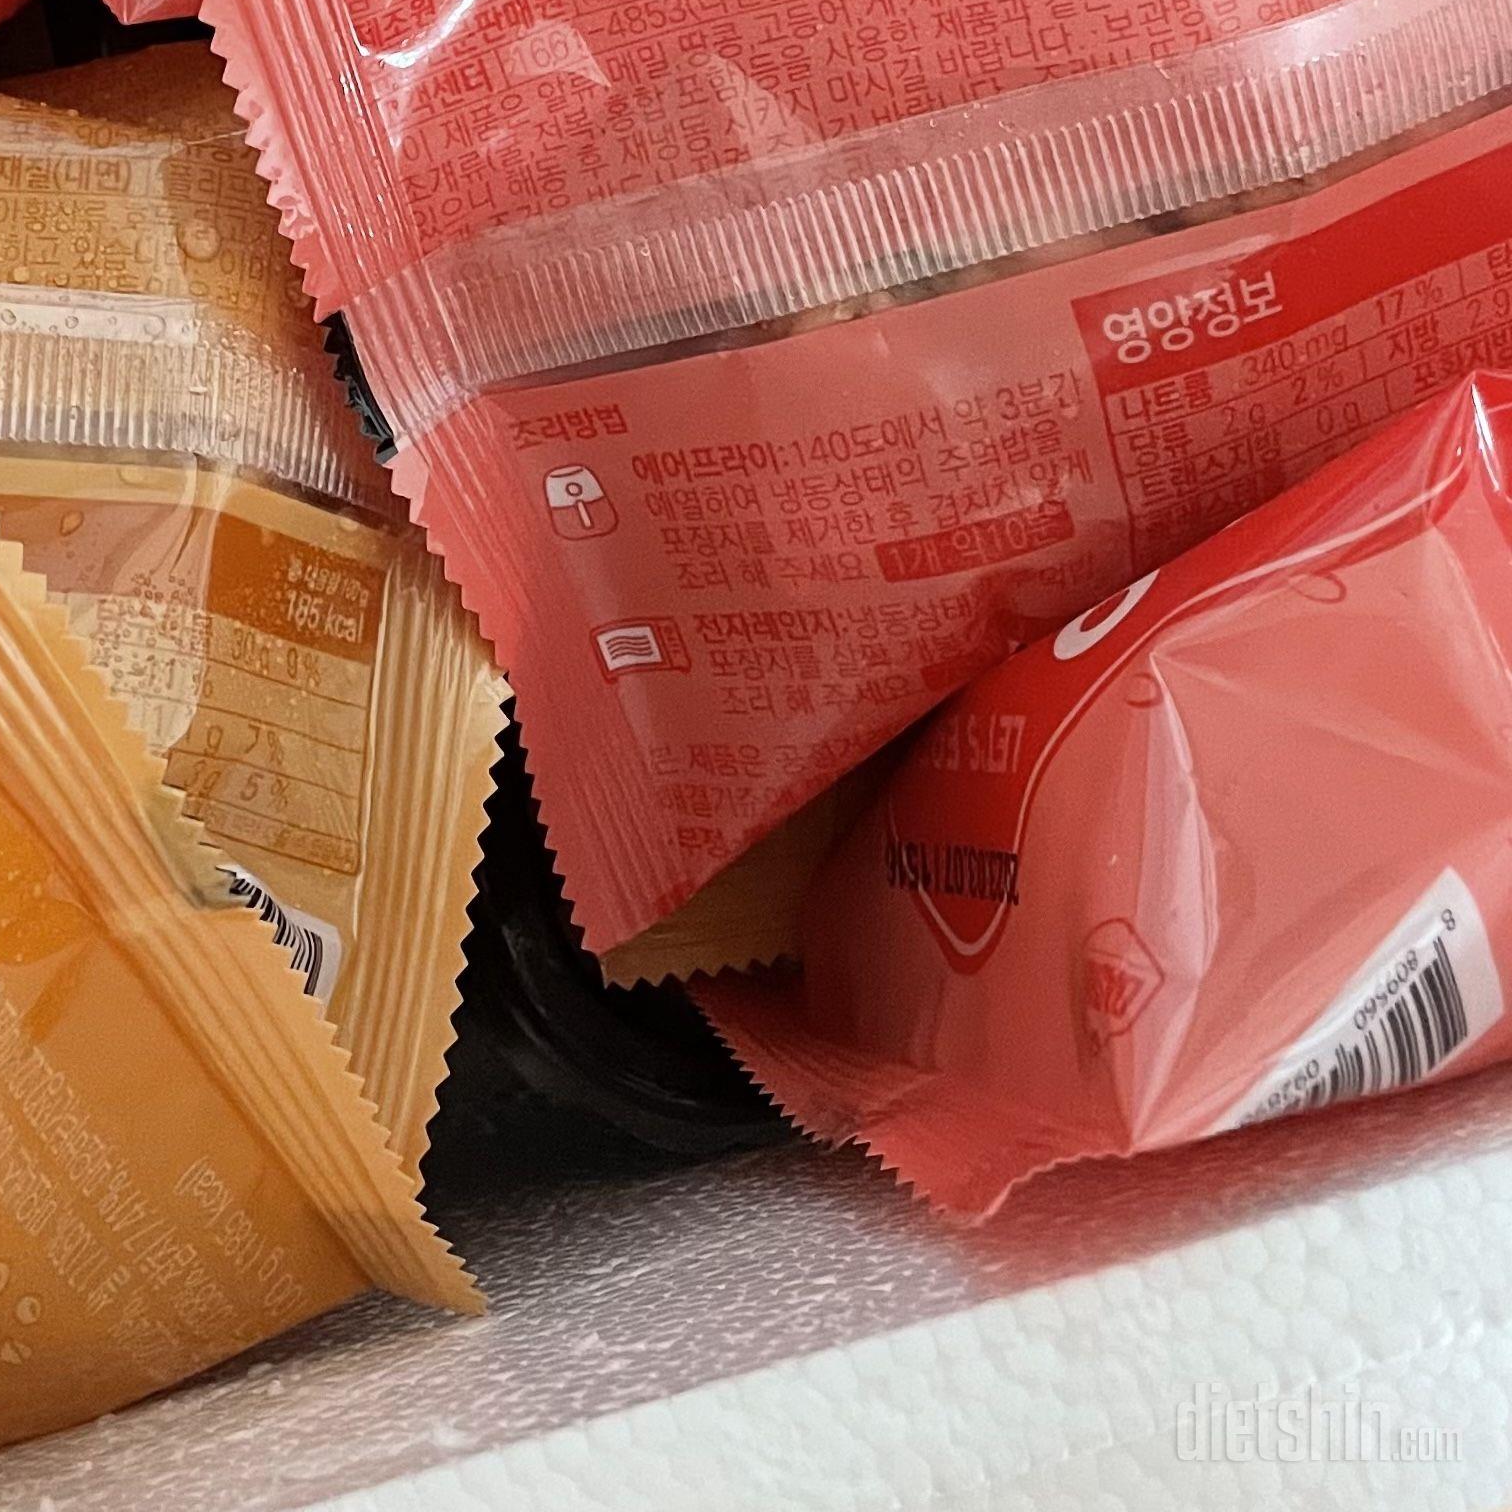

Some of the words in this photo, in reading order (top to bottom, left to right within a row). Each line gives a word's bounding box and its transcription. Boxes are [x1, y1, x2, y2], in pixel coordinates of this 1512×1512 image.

[824, 17, 921, 71] 사용한
[401, 131, 432, 165] 이
[439, 96, 532, 150] 제품은
[577, 145, 611, 178] 후
[617, 117, 711, 170] 재냉동
[826, 54, 929, 109] 마시길
[1103, 268, 1284, 366] 영양정보
[995, 369, 1084, 422] 3분간
[1120, 370, 1216, 428] 나트륨
[1239, 341, 1300, 384] 340
[509, 403, 628, 452] 조리방법
[1128, 420, 1194, 470] 당류
[785, 507, 876, 556] 제거한
[885, 499, 919, 536] 후
[677, 562, 729, 598] 조리
[739, 556, 769, 590] 해
[324, 606, 365, 643] kcal
